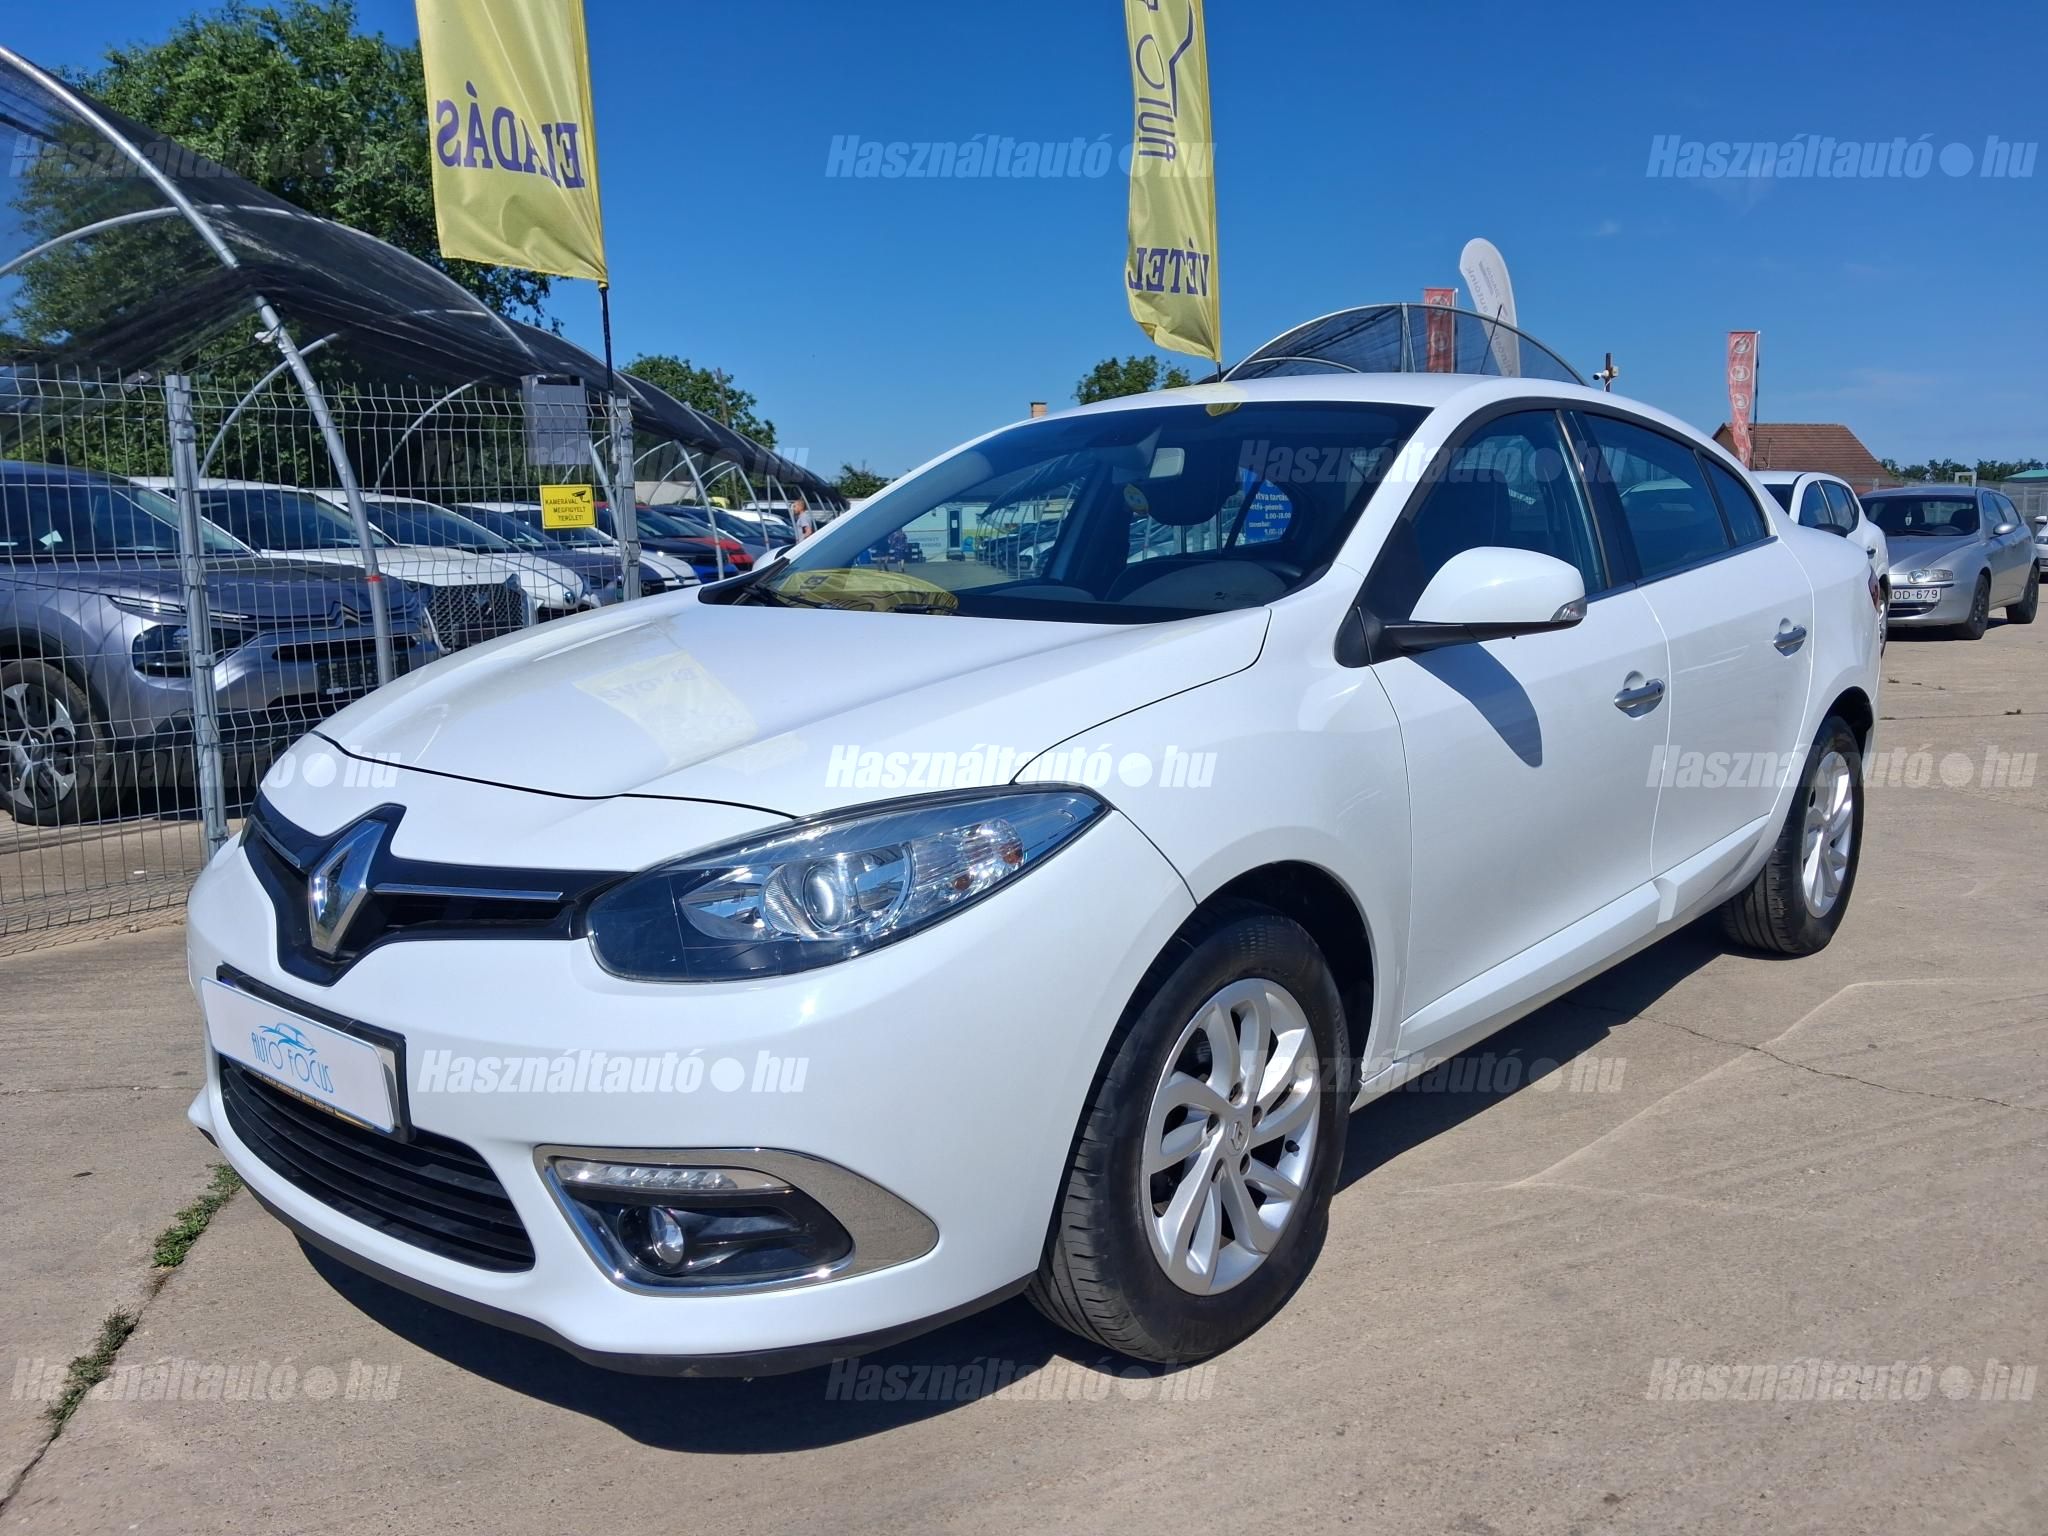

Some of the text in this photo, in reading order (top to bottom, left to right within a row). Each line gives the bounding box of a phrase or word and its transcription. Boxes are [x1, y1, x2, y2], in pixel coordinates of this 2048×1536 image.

[1890, 589, 1938, 600] OD-679
[251, 1031, 284, 1070] AUTO
[287, 1048, 334, 1094] FOCUS
